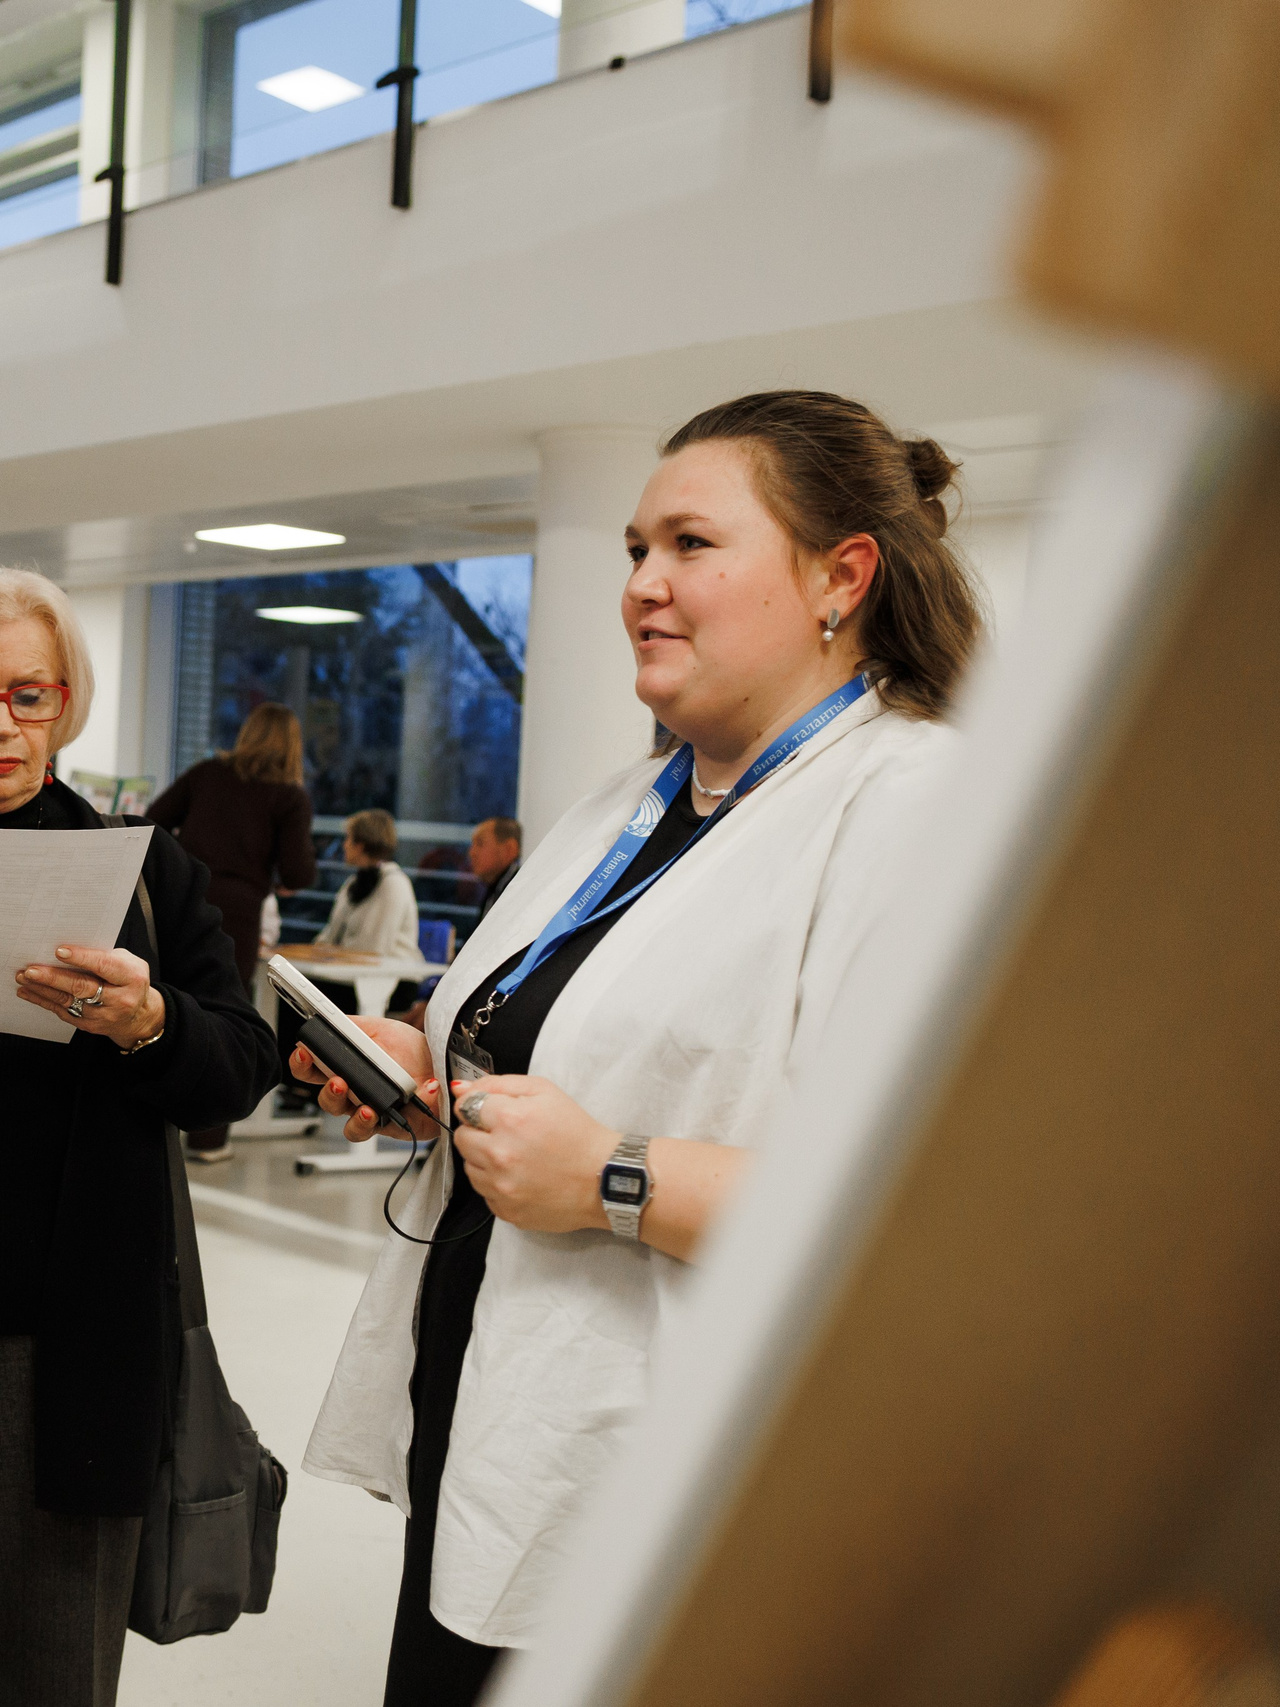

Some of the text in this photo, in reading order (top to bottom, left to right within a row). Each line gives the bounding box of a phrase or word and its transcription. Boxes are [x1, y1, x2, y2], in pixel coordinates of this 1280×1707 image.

[752, 695, 849, 775] Виват, таланты!
[596, 850, 629, 880] Виват,
[567, 879, 603, 921] таланты!
